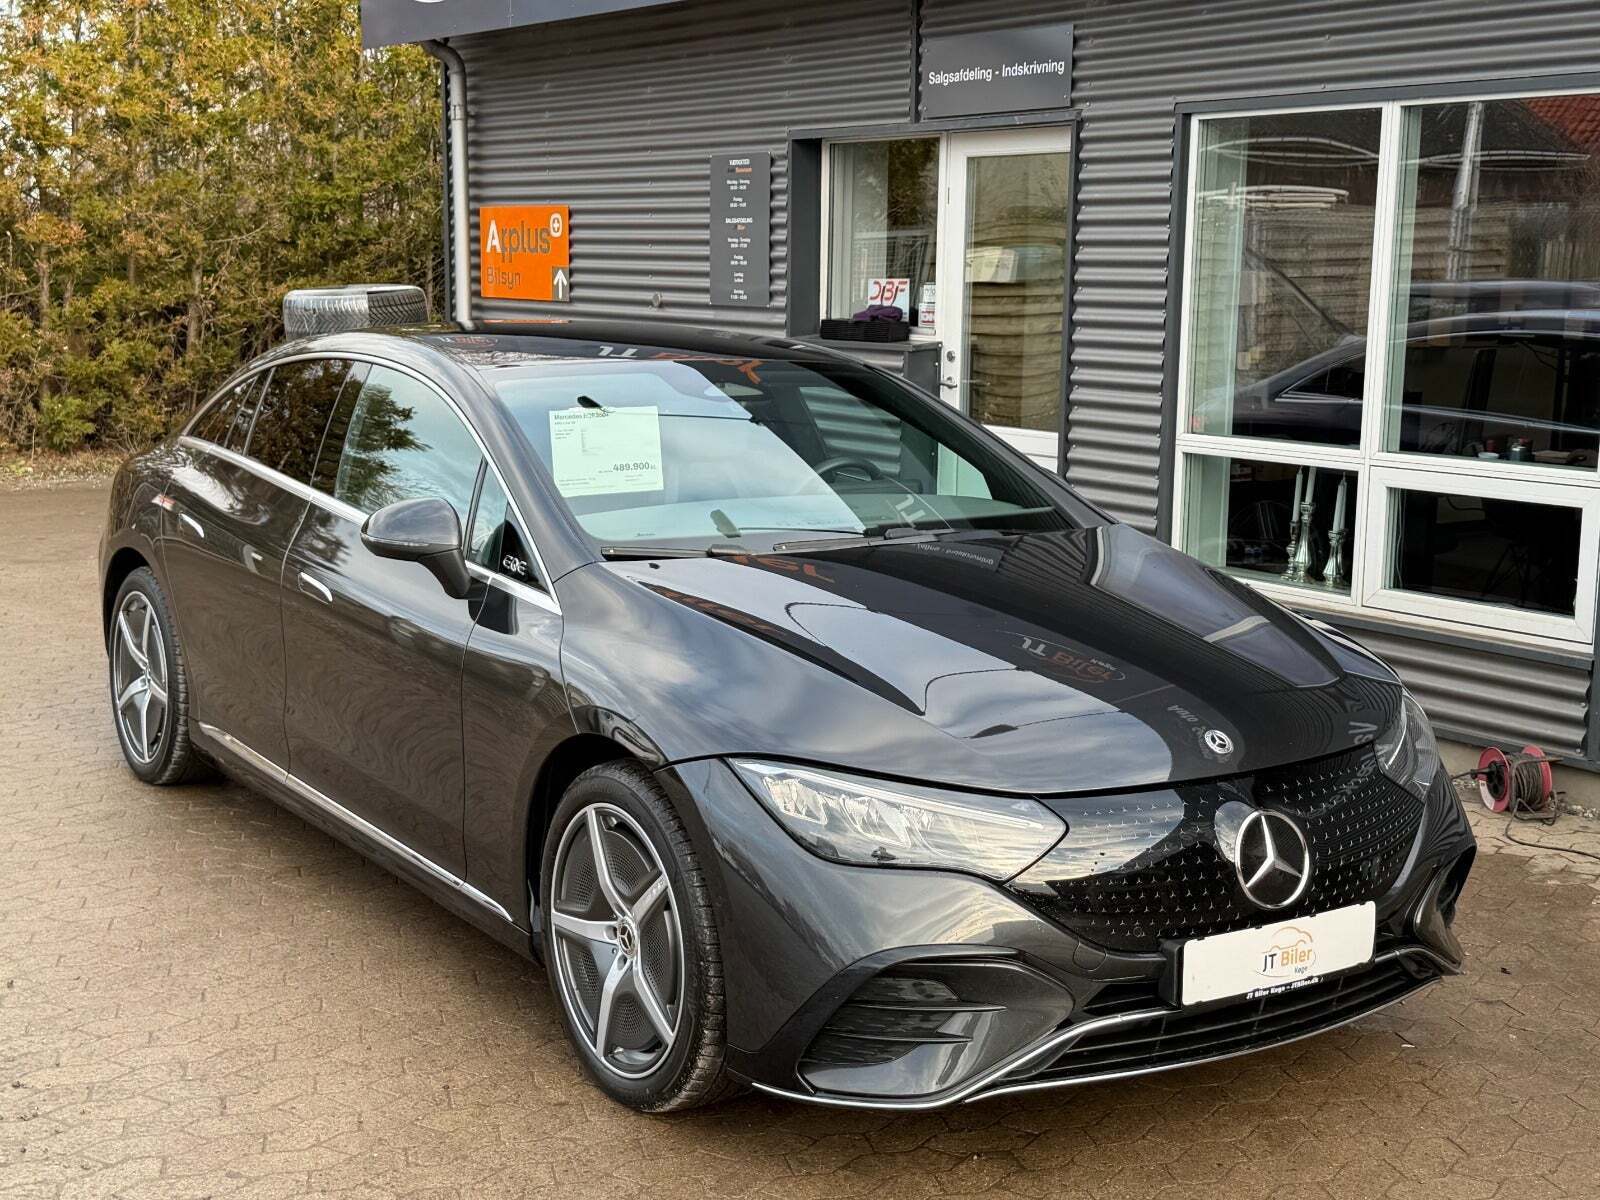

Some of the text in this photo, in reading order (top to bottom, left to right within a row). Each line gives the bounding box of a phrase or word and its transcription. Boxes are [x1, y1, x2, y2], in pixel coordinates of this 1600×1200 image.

[928, 67, 993, 86] Salgsafdeling
[1001, 59, 1065, 77] Indskrivning
[487, 266, 521, 290] Bilsyn
[612, 462, 650, 471] 489.900
[502, 554, 527, 576] EQE
[1263, 948, 1312, 972] JT Biler
